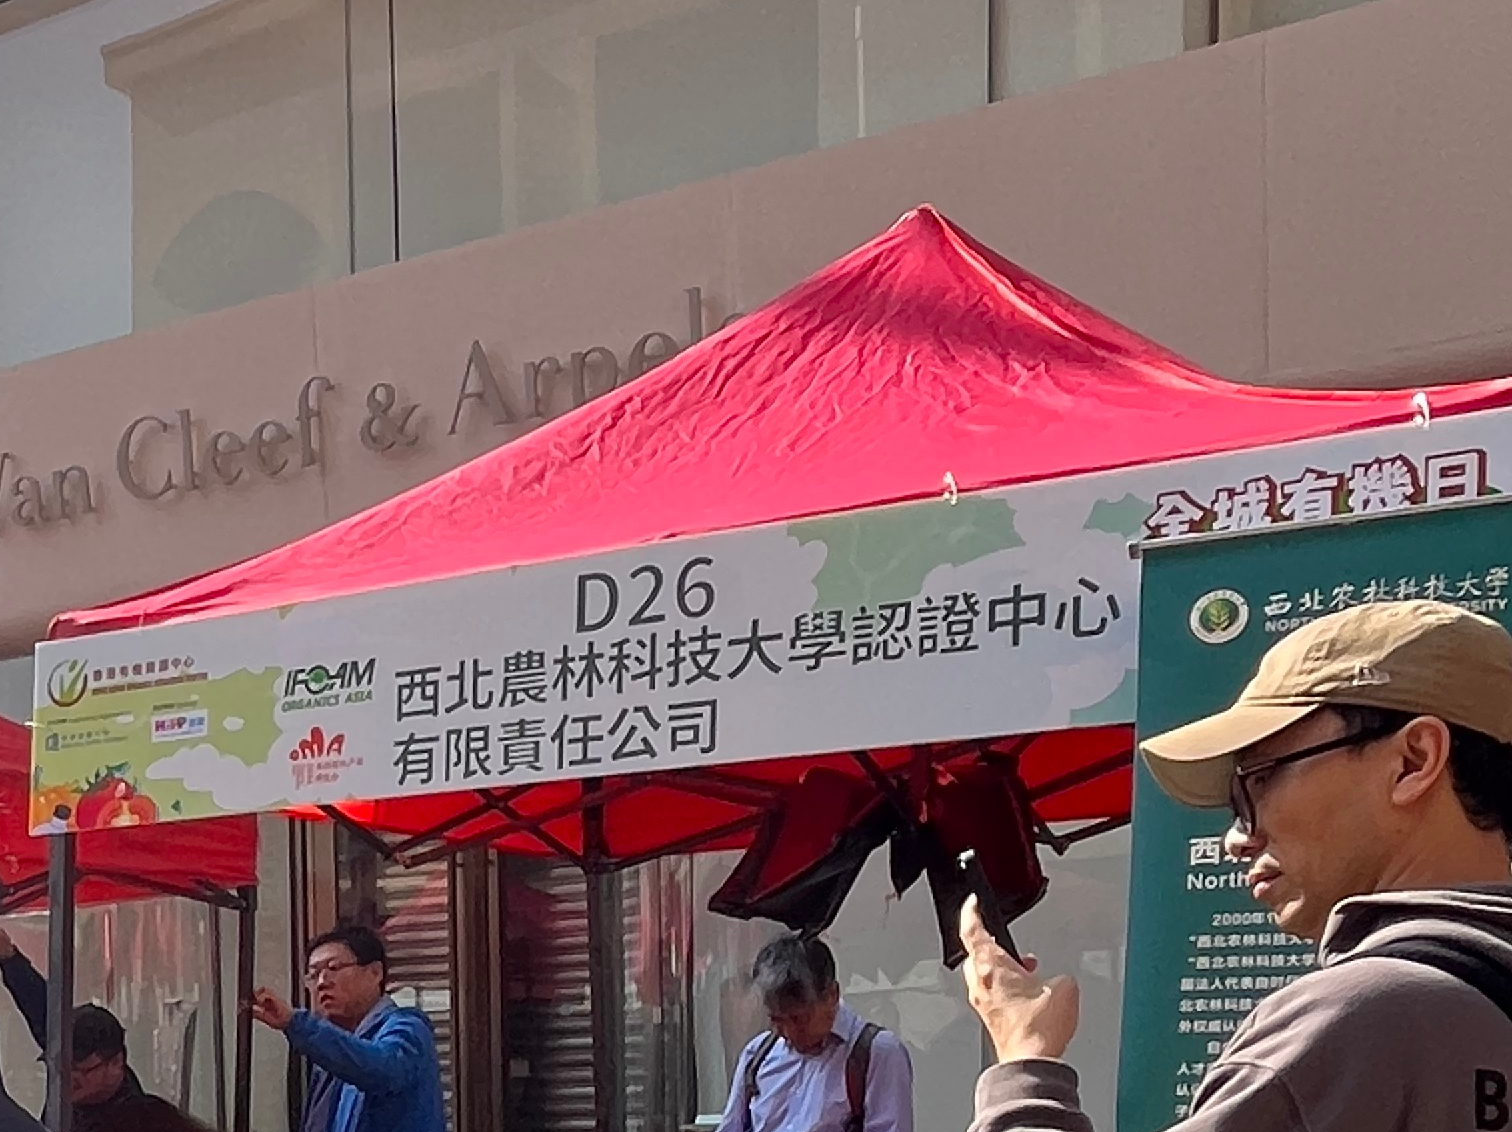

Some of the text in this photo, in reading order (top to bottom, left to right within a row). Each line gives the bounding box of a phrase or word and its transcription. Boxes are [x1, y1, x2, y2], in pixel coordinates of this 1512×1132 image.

[116, 375, 336, 501] Cleef
[358, 381, 421, 453] &
[447, 287, 749, 436] Arpel
[1142, 449, 1487, 539] 全城有機日
[575, 557, 716, 634] D26
[284, 657, 376, 697] IFOAM
[394, 577, 1122, 723] 西北農林科技大學認證中心
[391, 699, 720, 787] 有限責任公司
[1474, 1068, 1509, 1131] B
